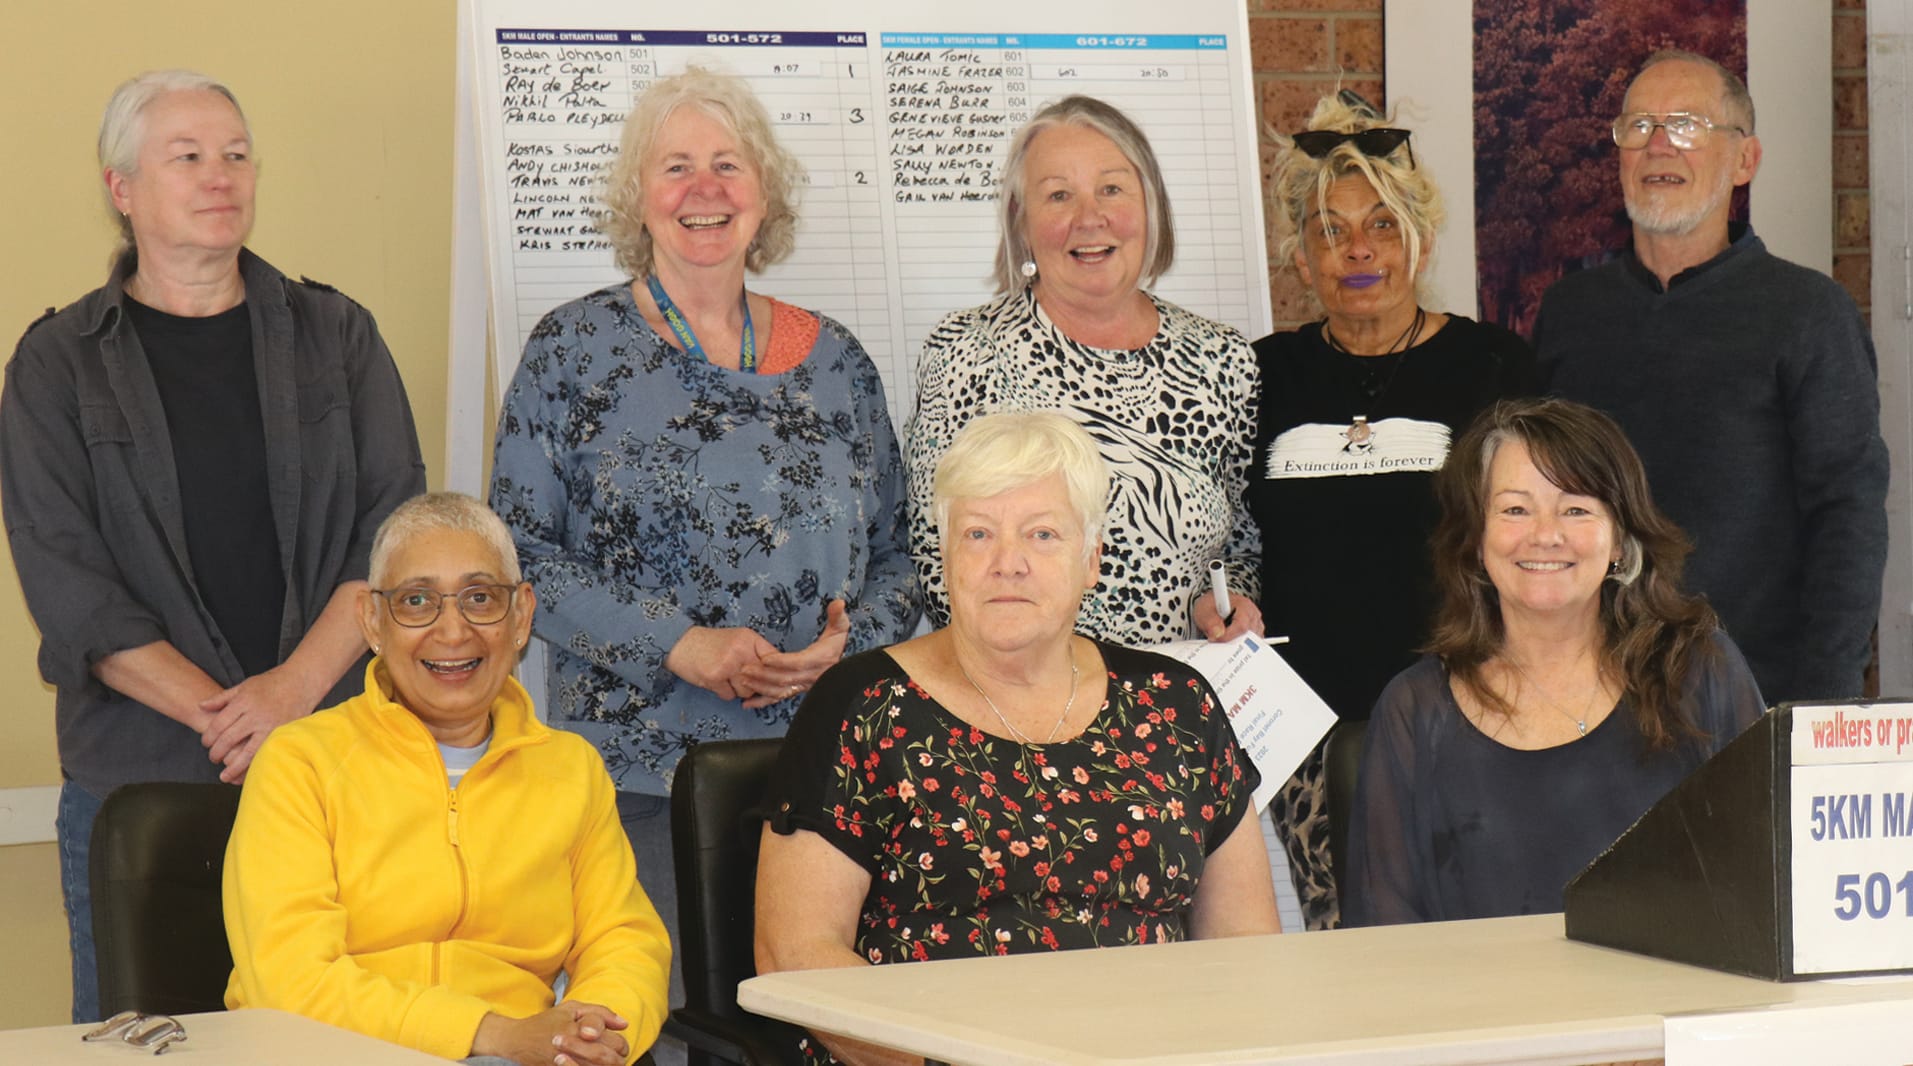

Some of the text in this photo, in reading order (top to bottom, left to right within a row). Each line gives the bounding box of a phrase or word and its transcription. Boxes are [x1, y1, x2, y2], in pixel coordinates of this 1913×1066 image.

[518, 32, 536, 40] MALE
[536, 32, 554, 40] OPEN
[560, 33, 594, 41] ENTRANTS
[595, 33, 618, 41] NAMES
[706, 34, 782, 43] 501-572
[837, 35, 864, 43] PLACE
[1076, 37, 1148, 46] 601-672
[1199, 38, 1224, 46] PLACE
[557, 48, 623, 62] Johnson
[629, 49, 648, 58] 501
[885, 51, 931, 63] LAURA
[1004, 52, 1022, 61] 601
[631, 64, 649, 74] 502
[848, 64, 854, 78] 1
[886, 63, 1003, 78] JASMINE FRAZER
[1006, 68, 1024, 76] 602
[505, 76, 535, 93] RAY
[542, 77, 561, 92] de
[888, 82, 928, 95] SAIGE
[1007, 83, 1025, 91] 603
[889, 98, 941, 108] SERENA
[1008, 98, 1026, 106] 604
[849, 108, 864, 124] 3
[1009, 113, 1028, 122] 605
[891, 127, 944, 140] MEGAN
[507, 142, 553, 157] KOSTAS
[890, 144, 993, 156] LISA WORDEN
[507, 159, 543, 177] ANDY
[939, 159, 994, 170] NEWTON
[854, 171, 868, 184] 2
[954, 173, 970, 185] de
[513, 192, 570, 204] LINCOLN
[896, 191, 926, 203] GAIL
[932, 192, 955, 201] VAN
[515, 206, 544, 220] MAT
[552, 210, 575, 218] VAN
[520, 240, 551, 250] KRIS
[1284, 456, 1434, 472] Extinction is forever
[1239, 684, 1257, 706] 3KM
[1812, 712, 1872, 748] walkers
[1877, 718, 1892, 745] or
[1810, 794, 1872, 841] 5KM
